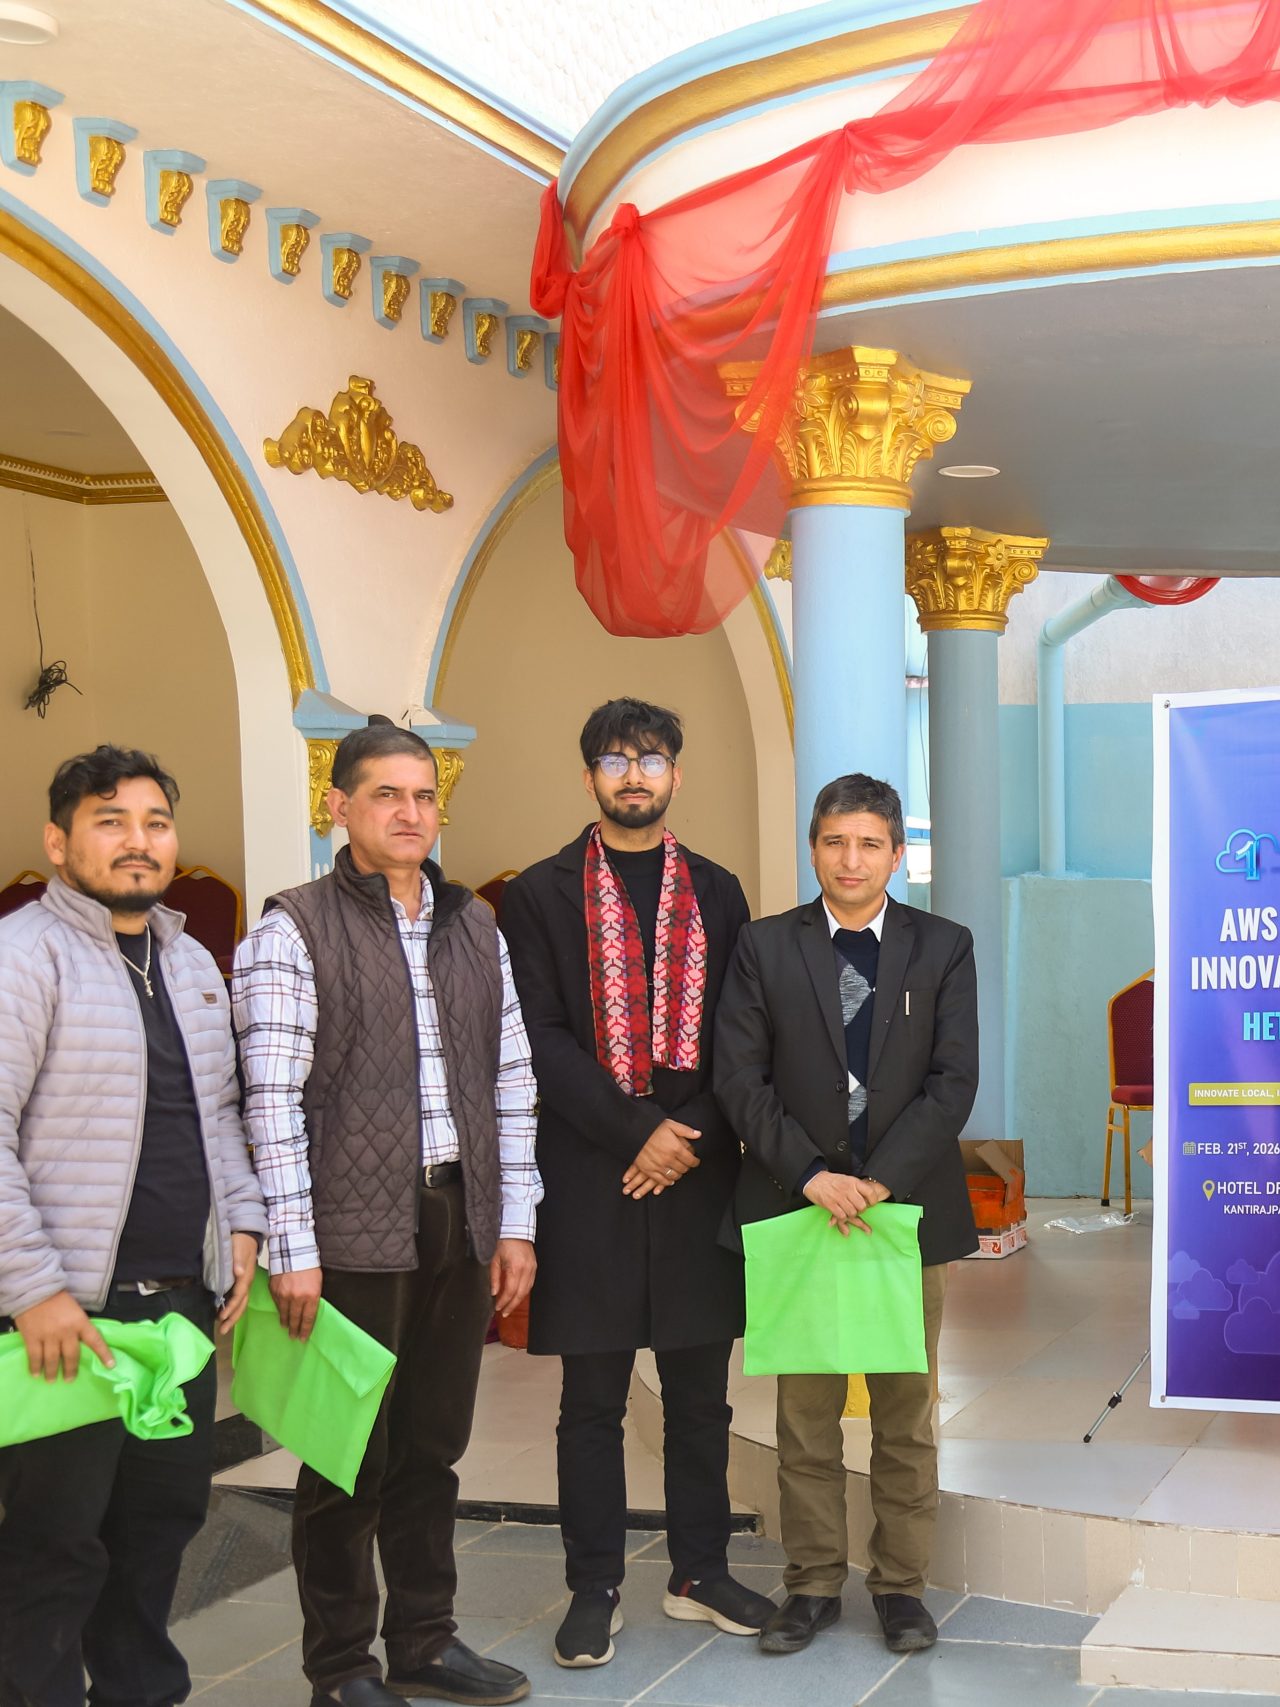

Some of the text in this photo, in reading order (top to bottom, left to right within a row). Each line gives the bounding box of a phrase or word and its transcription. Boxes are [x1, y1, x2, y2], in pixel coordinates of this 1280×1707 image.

[1219, 907, 1278, 942] AWS
[1194, 1089, 1239, 1098] INNOVATE
[1242, 1089, 1274, 1099] LOCAL,
[1197, 1143, 1223, 1155] FEB.
[1253, 1143, 1280, 1155] 2026
[1217, 1181, 1261, 1195] HOTEL
